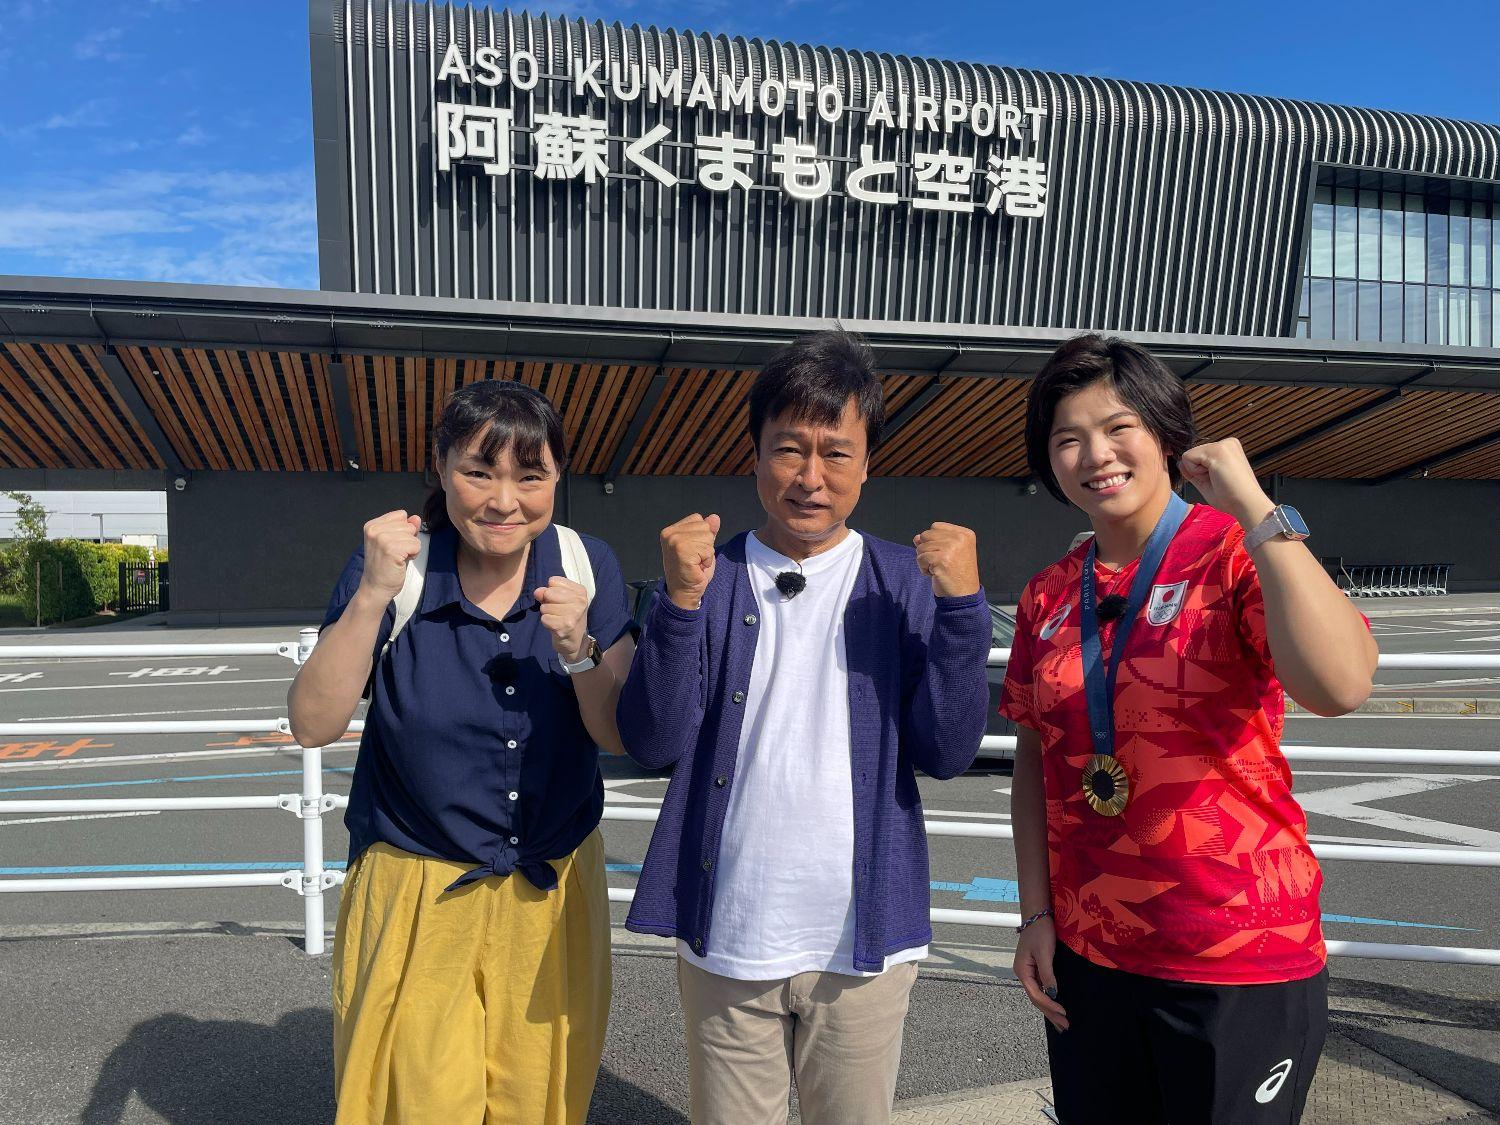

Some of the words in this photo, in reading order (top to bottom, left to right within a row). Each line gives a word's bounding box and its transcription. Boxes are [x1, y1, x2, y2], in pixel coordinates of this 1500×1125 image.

[437, 43, 539, 91] ASO
[574, 57, 843, 122] KUMAMOTO
[867, 91, 1048, 142] AIRPORT
[437, 102, 1047, 218] 阿蘇くまもと空港
